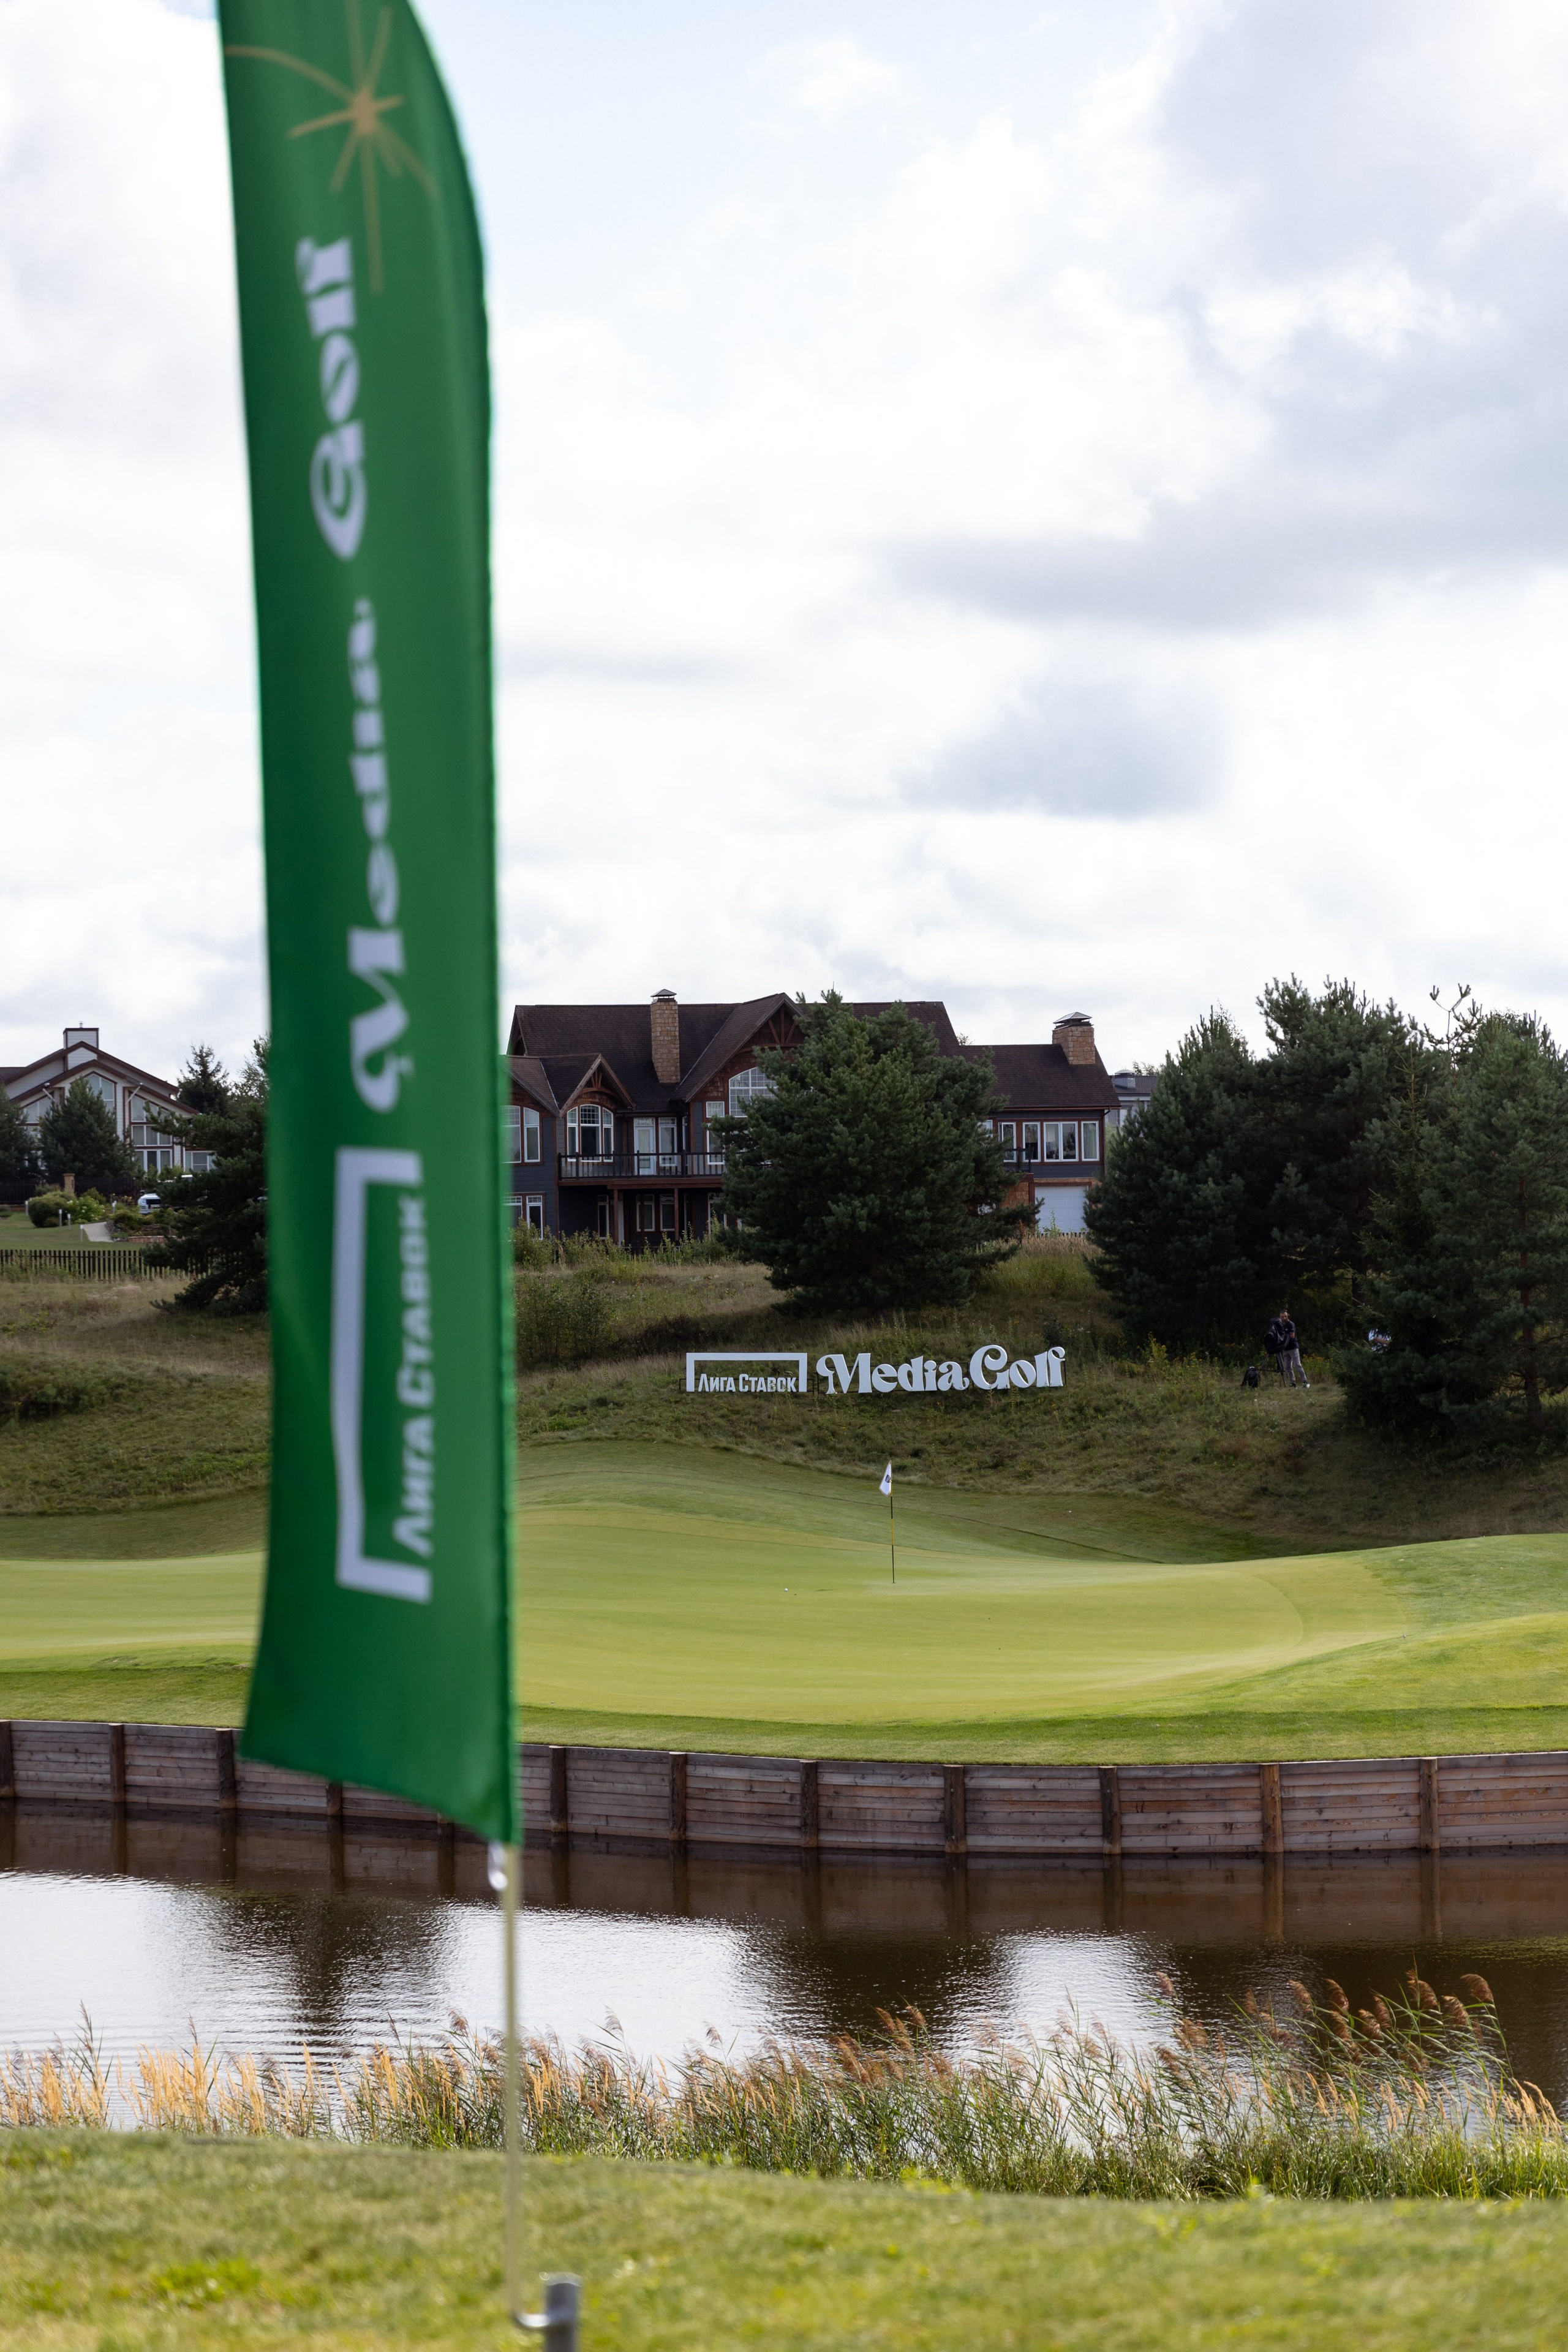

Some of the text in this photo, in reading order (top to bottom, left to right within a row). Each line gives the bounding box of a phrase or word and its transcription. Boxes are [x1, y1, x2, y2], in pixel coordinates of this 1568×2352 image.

[295, 236, 414, 1112] Media Golf
[816, 1344, 1066, 1394] Media Golf
